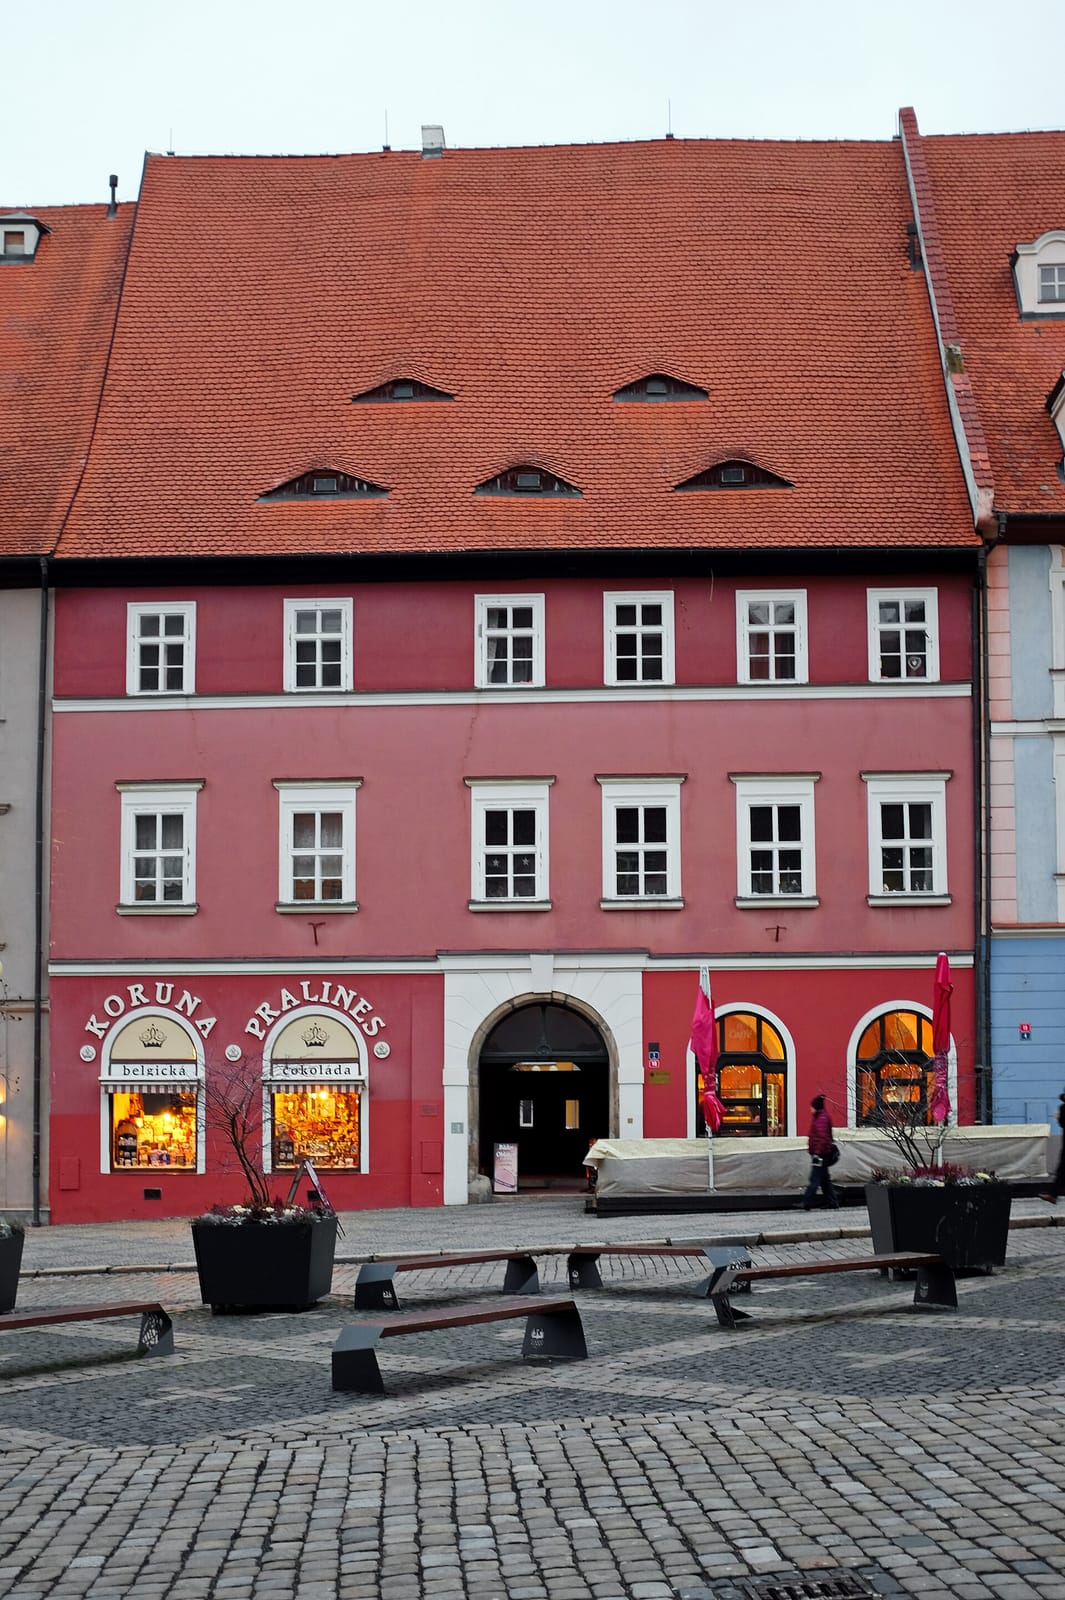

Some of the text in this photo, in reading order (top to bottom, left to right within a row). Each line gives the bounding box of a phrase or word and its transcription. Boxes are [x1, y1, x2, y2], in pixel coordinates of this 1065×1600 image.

[85, 982, 217, 1039] KORUNA
[245, 980, 387, 1041] PRALINES
[123, 1064, 186, 1077] belgická
